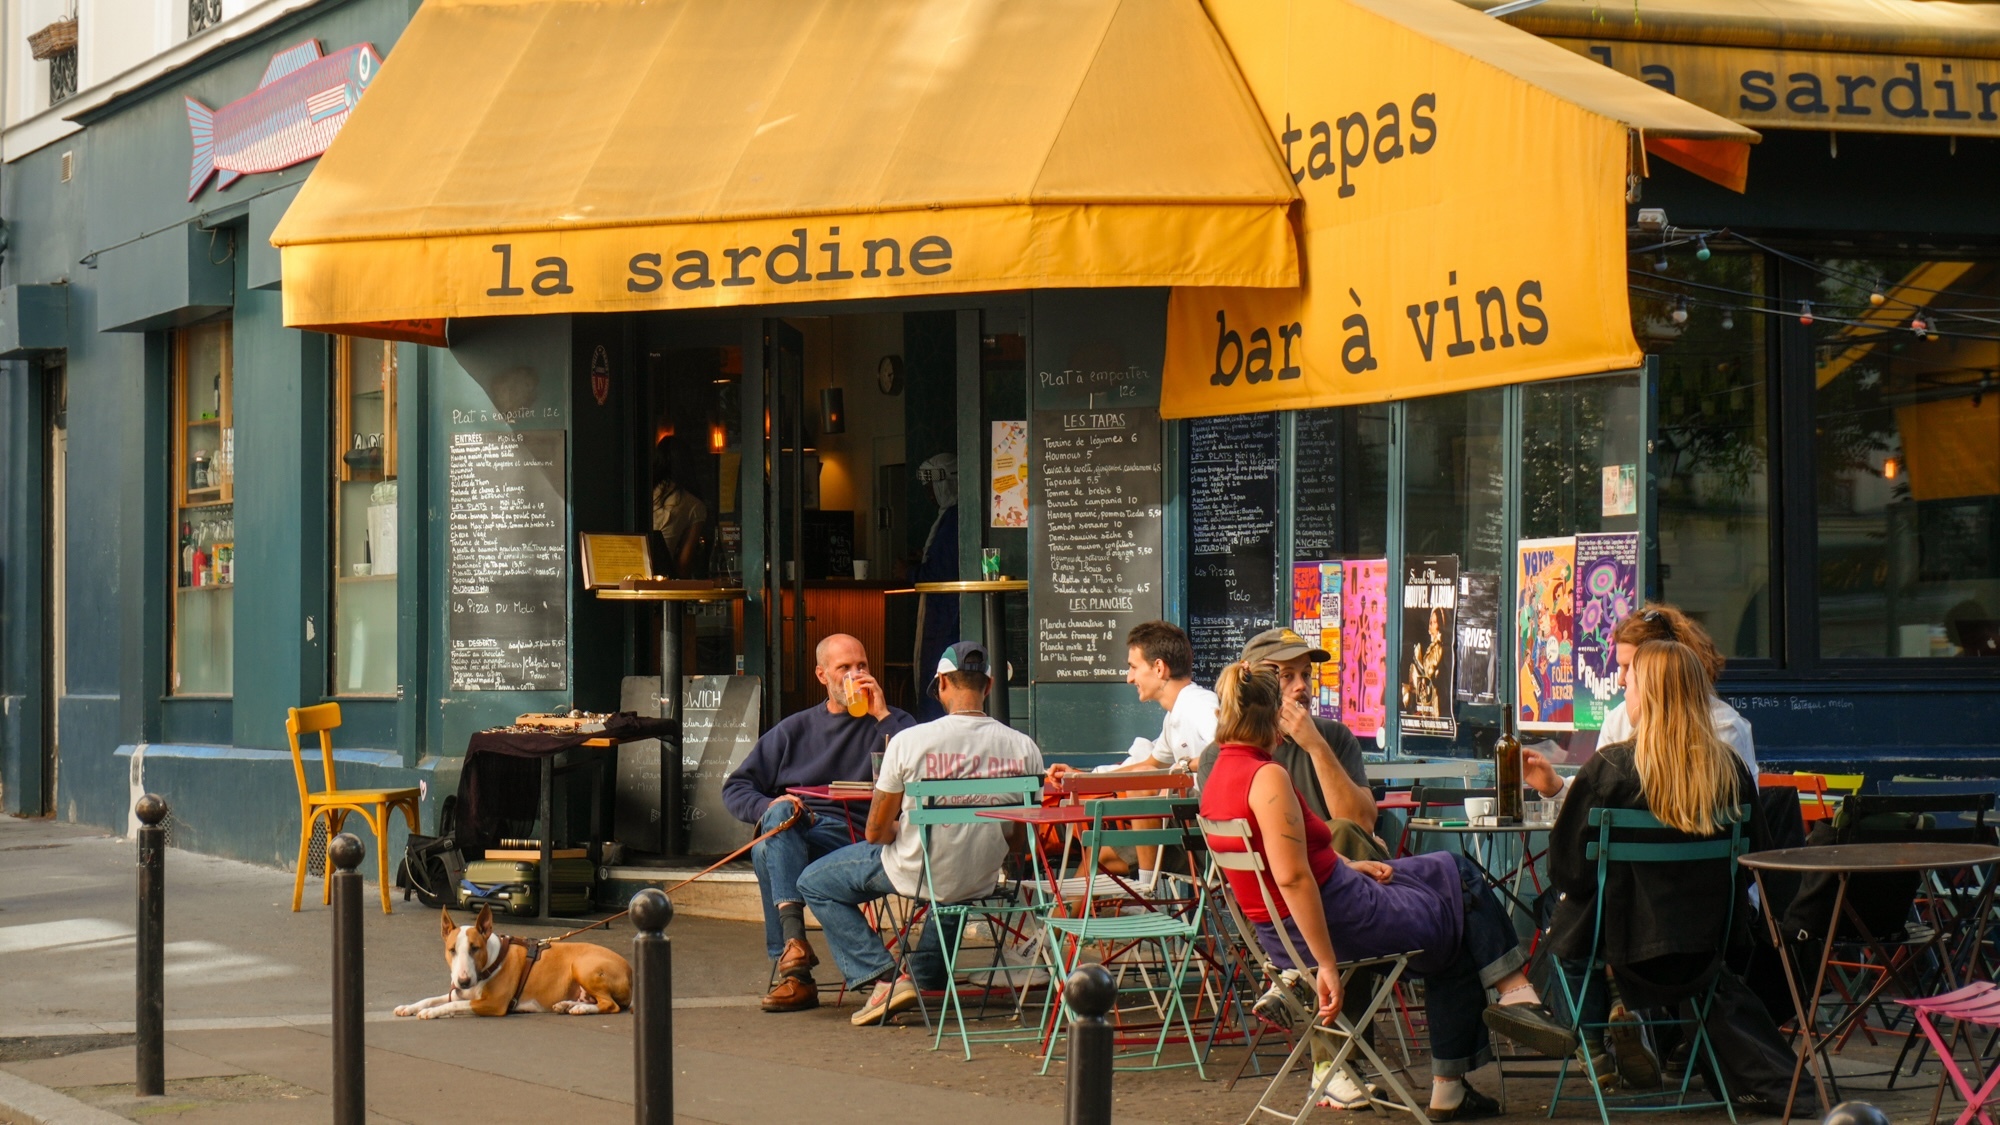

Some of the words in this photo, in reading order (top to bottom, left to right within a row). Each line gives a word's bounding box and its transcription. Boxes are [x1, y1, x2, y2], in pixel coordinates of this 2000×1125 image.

[1281, 92, 1437, 199] tapas
[486, 243, 575, 297] la
[626, 226, 954, 293] sardine
[1209, 309, 1302, 387] bar
[1340, 287, 1378, 374] à
[1405, 270, 1549, 362] vins
[452, 409, 477, 424] Plat
[1064, 414, 1086, 428] LES
[1090, 412, 1126, 428] TAPAS
[454, 431, 483, 444] ENTRÉES
[1044, 437, 1072, 449] Terrine
[1076, 438, 1085, 447] de
[1090, 434, 1123, 449] légumes
[1131, 433, 1138, 443] 6
[1045, 451, 1081, 462] Houmous
[1086, 449, 1093, 460] 5
[1208, 452, 1232, 461] PLATS
[1045, 477, 1082, 489] Tapenade
[1045, 488, 1070, 498] Tomme
[1075, 488, 1084, 496] de
[1089, 486, 1112, 496] brebis
[1116, 485, 1122, 495] 8
[1047, 499, 1078, 509] Burrata
[1085, 497, 1123, 509] campania
[1128, 496, 1138, 505] 10
[1047, 510, 1072, 523] Hareng
[1114, 520, 1122, 528] 10
[1128, 530, 1134, 539] 8
[1295, 538, 1329, 548] ANCHES
[1138, 546, 1153, 556] 5,50
[1315, 549, 1323, 558] 18
[1106, 565, 1112, 573] 6
[1208, 563, 1235, 577] Pizza
[1408, 567, 1426, 585] Sarah
[1427, 566, 1452, 585] Maison
[1083, 576, 1090, 584] de
[1117, 574, 1123, 583] 6
[1224, 579, 1237, 588] DU
[1080, 586, 1088, 594] de
[1404, 584, 1429, 609] NOUVEL
[1430, 585, 1455, 609] ALBUM
[467, 598, 490, 614] Pizza
[496, 602, 508, 613] DU
[1069, 598, 1087, 610] LES
[1089, 596, 1134, 610] PLANCHES
[1040, 618, 1067, 630] Planche
[1108, 619, 1117, 629] 18
[452, 639, 464, 648] LES
[468, 638, 498, 648] DESSERTS
[1040, 630, 1068, 641] Planche
[1071, 631, 1099, 644] fromage
[1103, 631, 1113, 641] 18
[1463, 627, 1492, 648] RIVES
[1087, 644, 1098, 653] 22
[1040, 653, 1050, 662] La
[1070, 652, 1095, 666] fromage
[1752, 697, 1780, 710] FRAIS
[926, 753, 966, 779] BIKE
[968, 755, 983, 779] &
